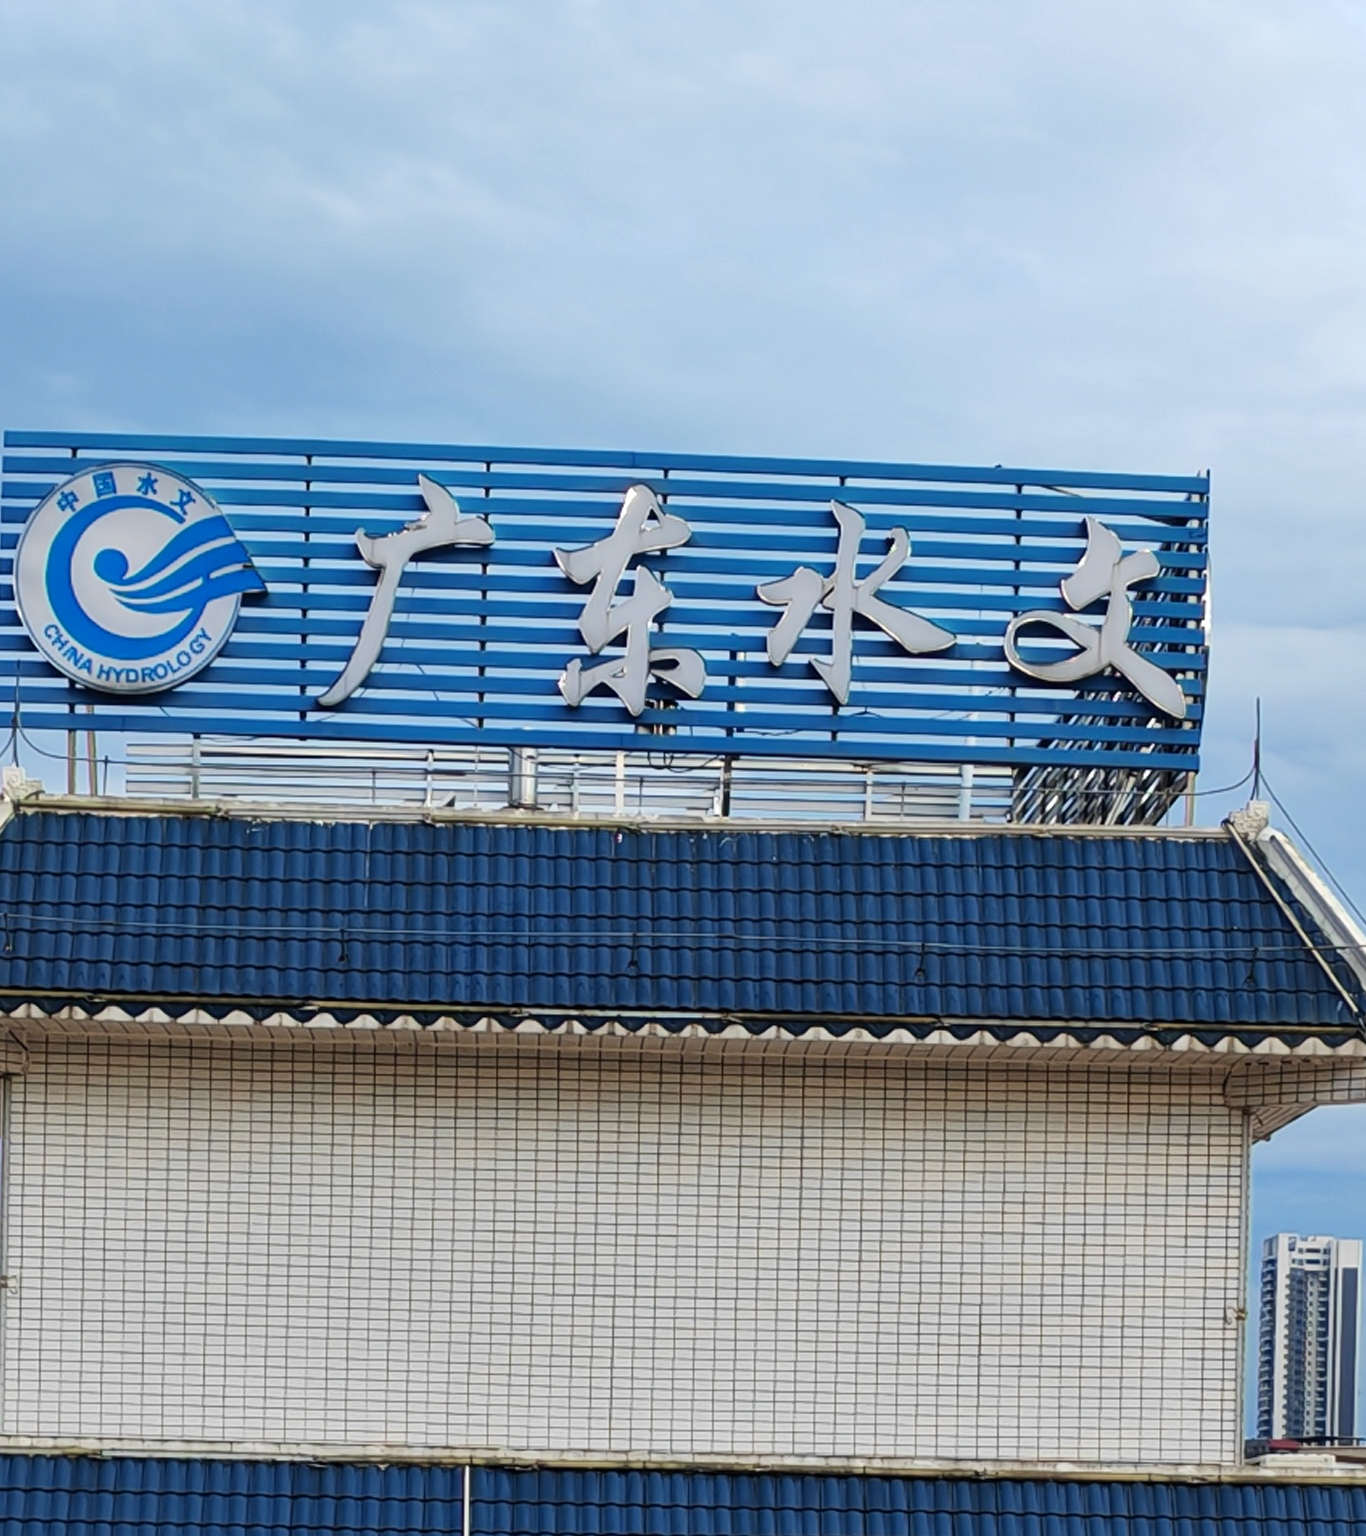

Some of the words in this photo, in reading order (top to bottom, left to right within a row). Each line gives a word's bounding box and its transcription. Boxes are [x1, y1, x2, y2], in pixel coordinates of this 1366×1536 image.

[56, 471, 197, 516] 中国水文
[318, 473, 1187, 719] 广东水文
[43, 623, 93, 675] CHINA
[96, 626, 214, 684] HYDROLOGY
